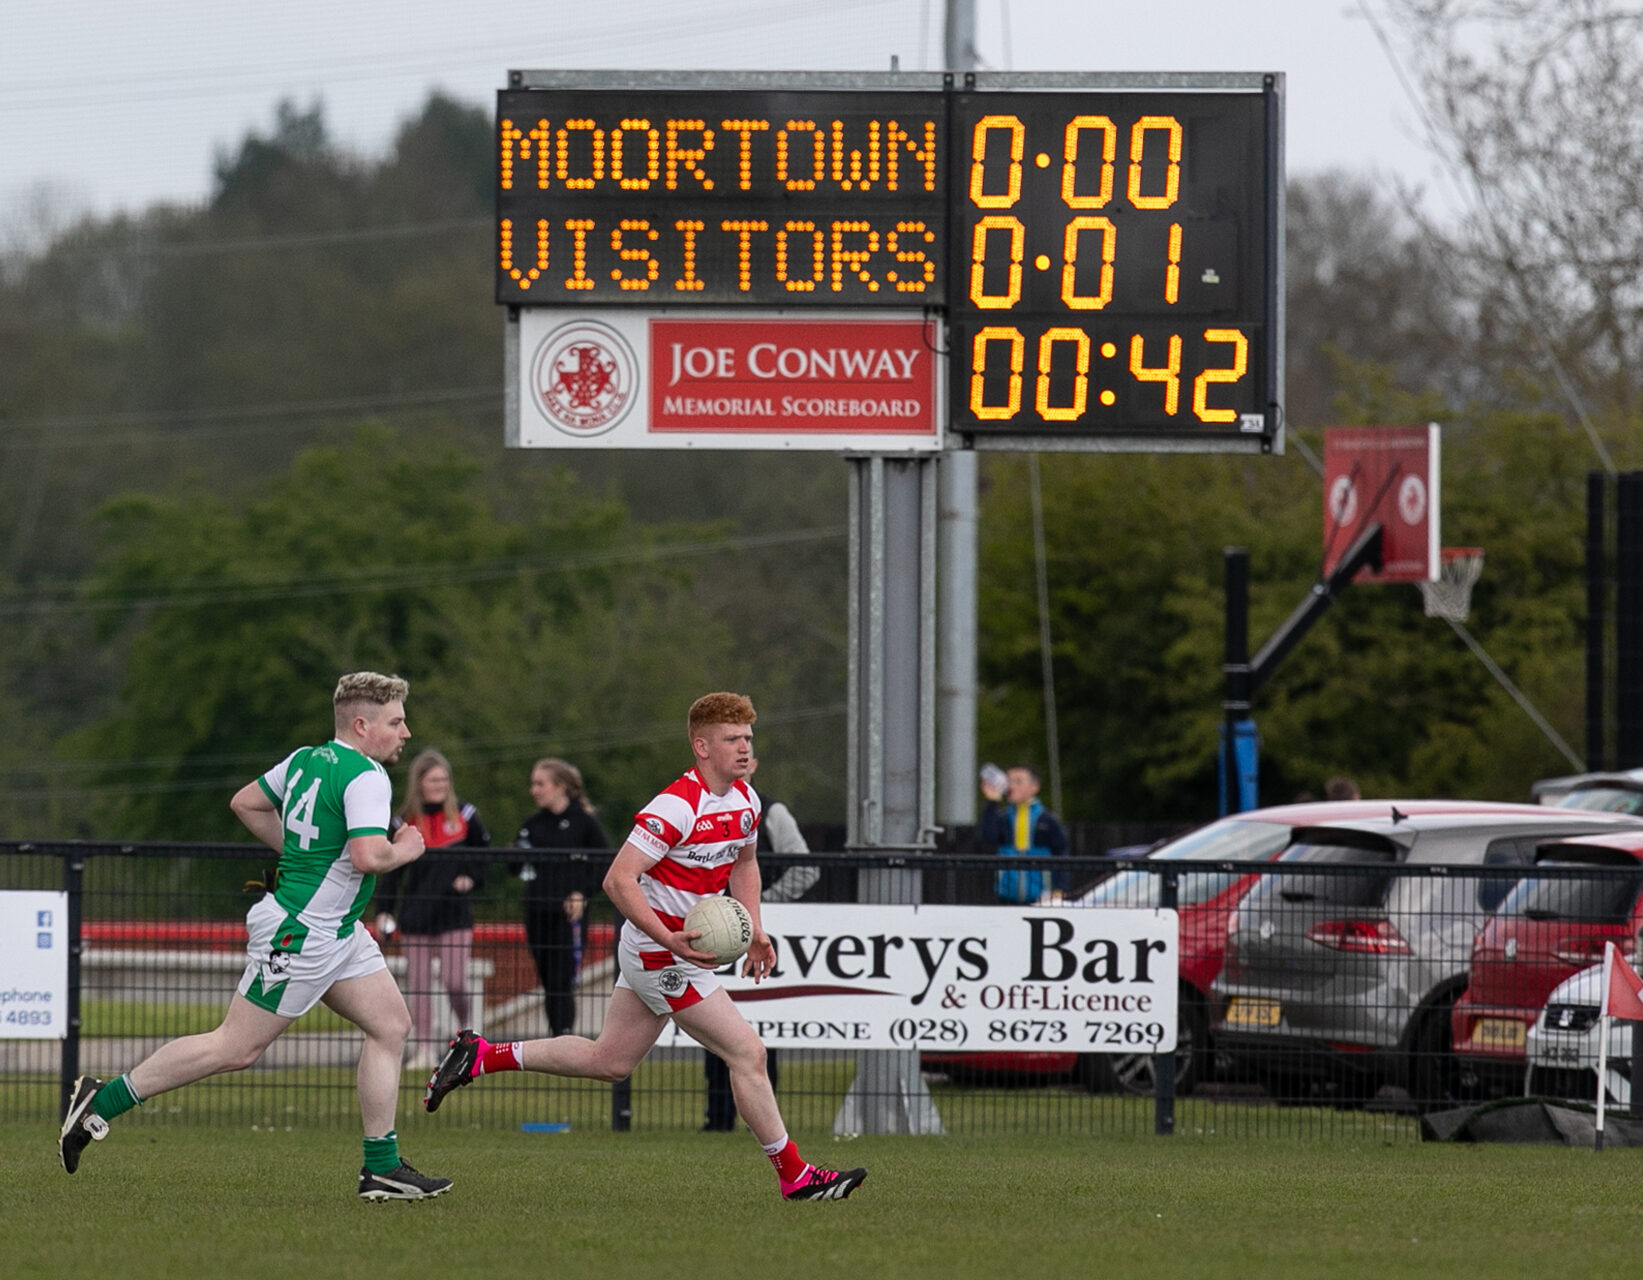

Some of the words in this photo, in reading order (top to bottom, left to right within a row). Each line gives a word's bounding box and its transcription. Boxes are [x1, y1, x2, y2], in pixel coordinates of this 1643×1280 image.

[500, 118, 936, 192] MOORTOWN
[500, 218, 936, 292] VISITORS
[669, 343, 736, 385] JOE
[747, 343, 920, 379] CONWAY
[969, 326, 1249, 423] 00:42
[663, 396, 776, 416] MEMORIAL
[781, 396, 920, 417] SCOREBOARD
[281, 768, 322, 851] 14
[722, 822, 730, 838] 3
[1022, 917, 1167, 984] Bar
[0, 987, 52, 1006] phone
[940, 984, 967, 1010] &
[979, 984, 1152, 1013] Off-Licence
[889, 1018, 969, 1045] (028)
[988, 1020, 1068, 1043] 8673
[1085, 1021, 1165, 1044] 7269
